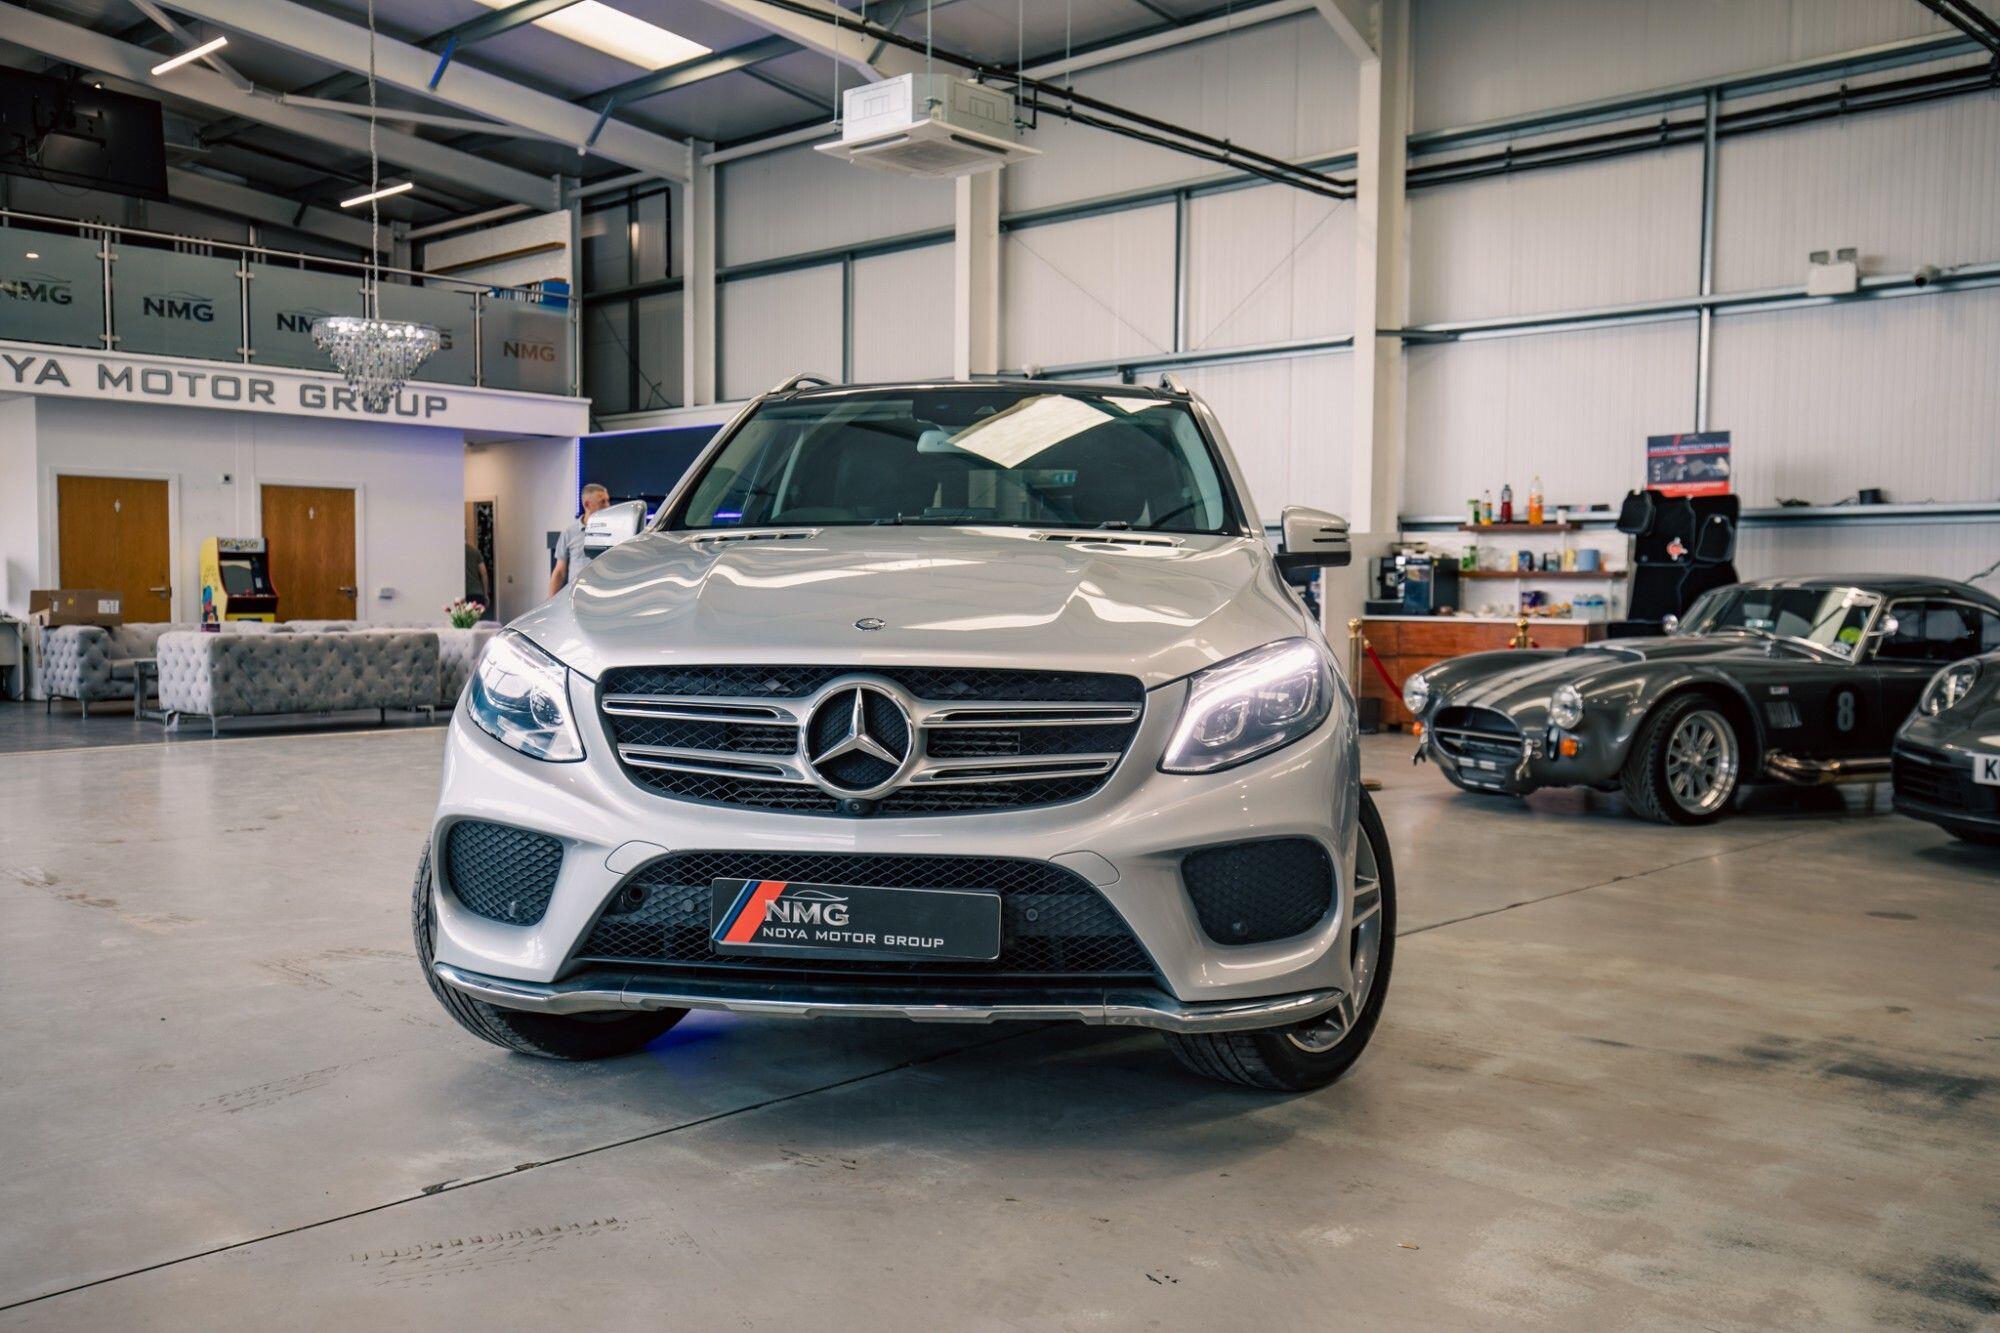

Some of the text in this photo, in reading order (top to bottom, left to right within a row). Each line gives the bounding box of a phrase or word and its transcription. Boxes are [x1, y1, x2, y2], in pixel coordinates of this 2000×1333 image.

[142, 296, 214, 322] NMG
[276, 313, 313, 333] NM
[503, 341, 556, 363] NMG
[2, 354, 71, 387] YA
[98, 363, 275, 404] MOTOR
[1838, 691, 1854, 731] 8
[1984, 758, 2000, 780] K
[764, 899, 850, 926] NMG
[762, 927, 945, 948] NOYA MOTOR GROUP
